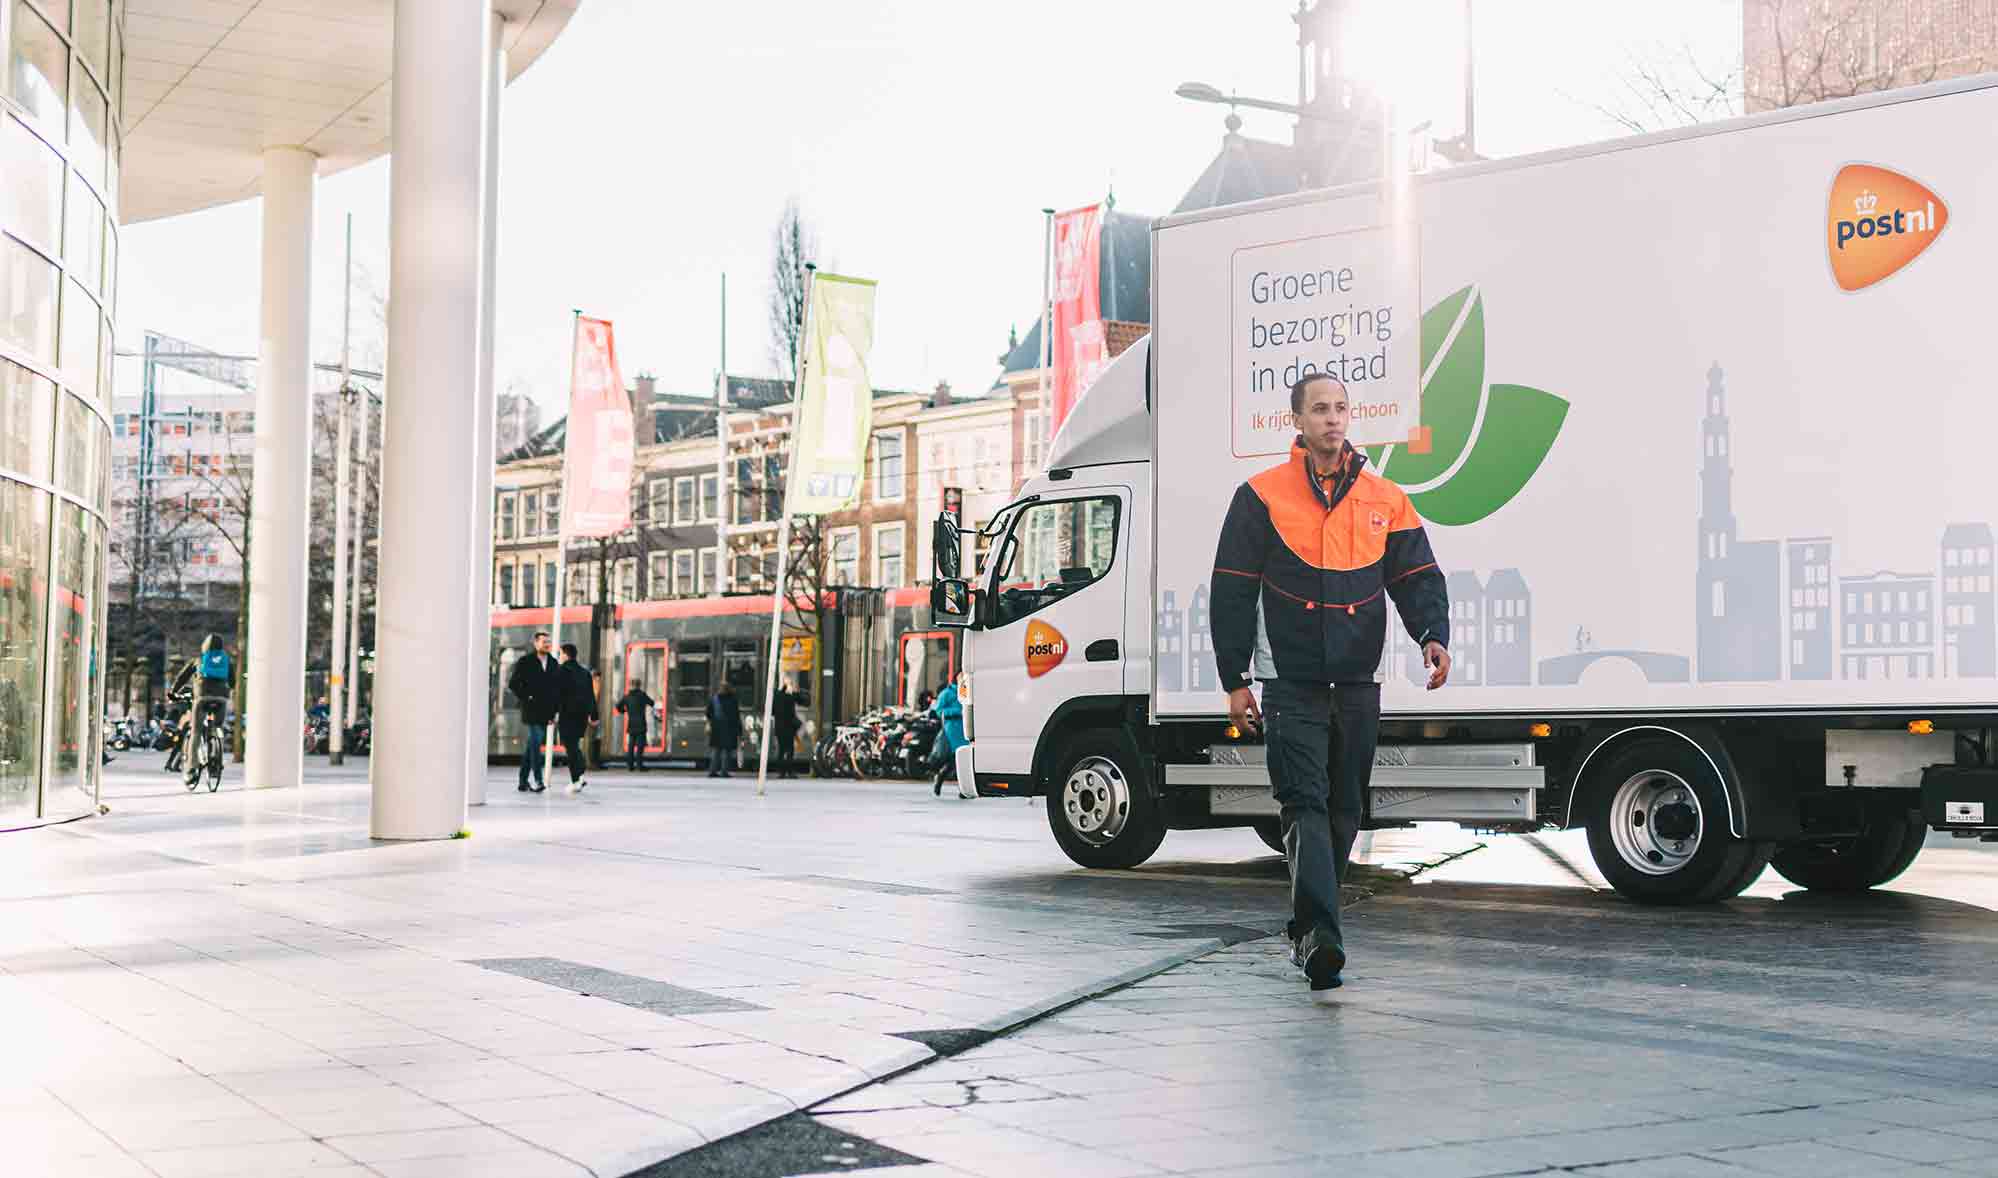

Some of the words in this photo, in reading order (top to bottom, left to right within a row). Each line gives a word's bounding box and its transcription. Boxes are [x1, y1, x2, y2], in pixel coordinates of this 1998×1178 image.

[1837, 200, 1935, 250] postnl
[1251, 267, 1353, 304] Groene
[1252, 304, 1393, 348] bezorging
[1252, 361, 1275, 392] in
[1326, 346, 1386, 383] stad
[1252, 410, 1265, 430] Ik
[1350, 401, 1399, 420] choon
[1028, 640, 1064, 659] postnl
